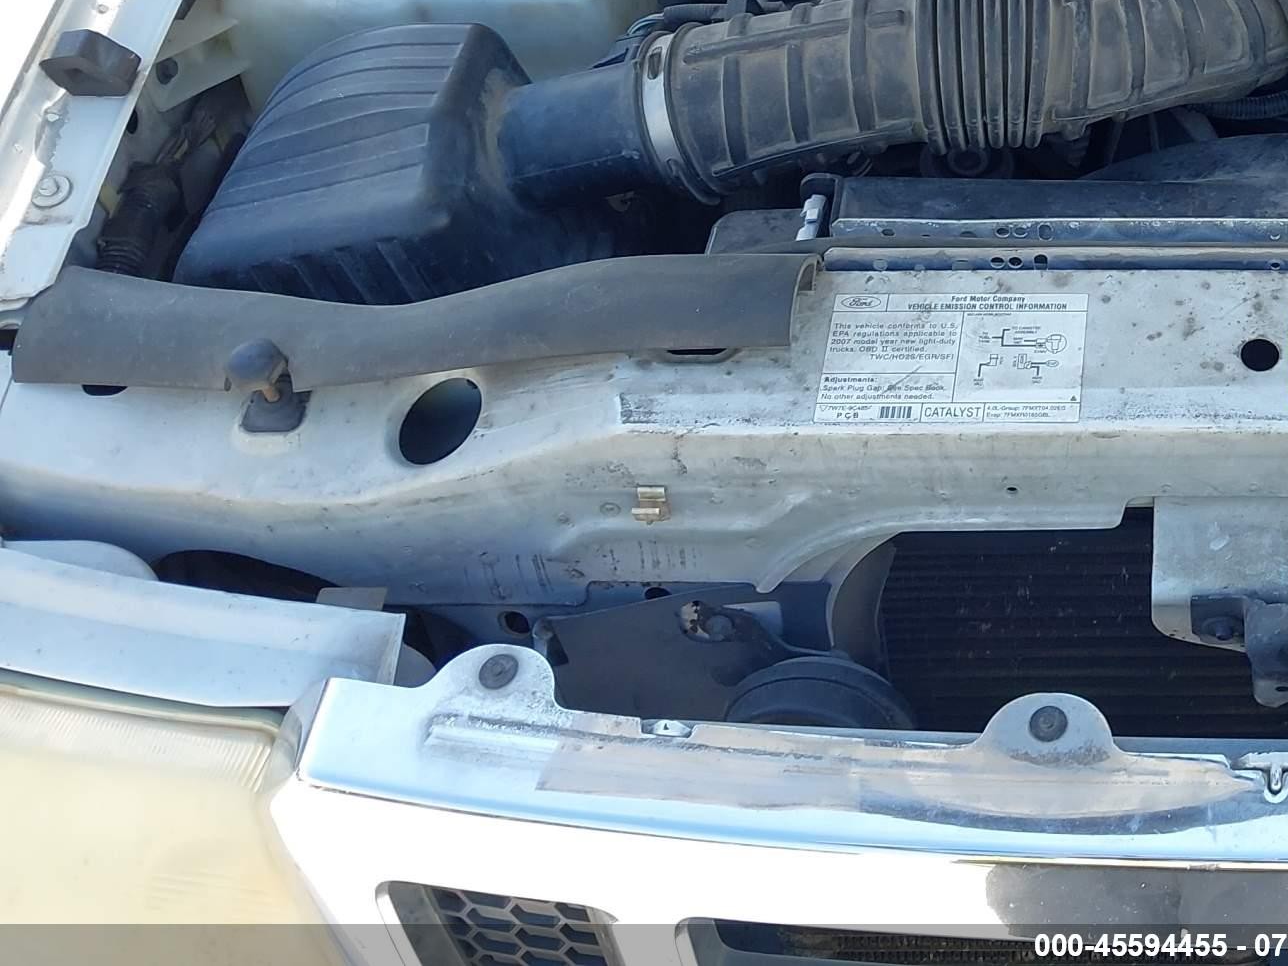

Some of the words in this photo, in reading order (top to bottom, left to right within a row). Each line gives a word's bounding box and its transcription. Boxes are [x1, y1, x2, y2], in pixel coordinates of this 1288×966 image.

[951, 295, 968, 303] Ford
[970, 295, 990, 303] Motor
[992, 295, 1026, 303] Company
[832, 330, 849, 338] EPA
[853, 330, 900, 338] regulations
[903, 330, 945, 338] applicable
[831, 338, 852, 346] 2007
[853, 338, 878, 346] model
[880, 338, 898, 346] year
[900, 338, 916, 346] new
[919, 338, 956, 346] light-duty
[823, 384, 845, 392] Spark
[847, 384, 865, 392] Plug
[904, 384, 923, 392] Spec
[924, 406, 981, 419] CATALYST
